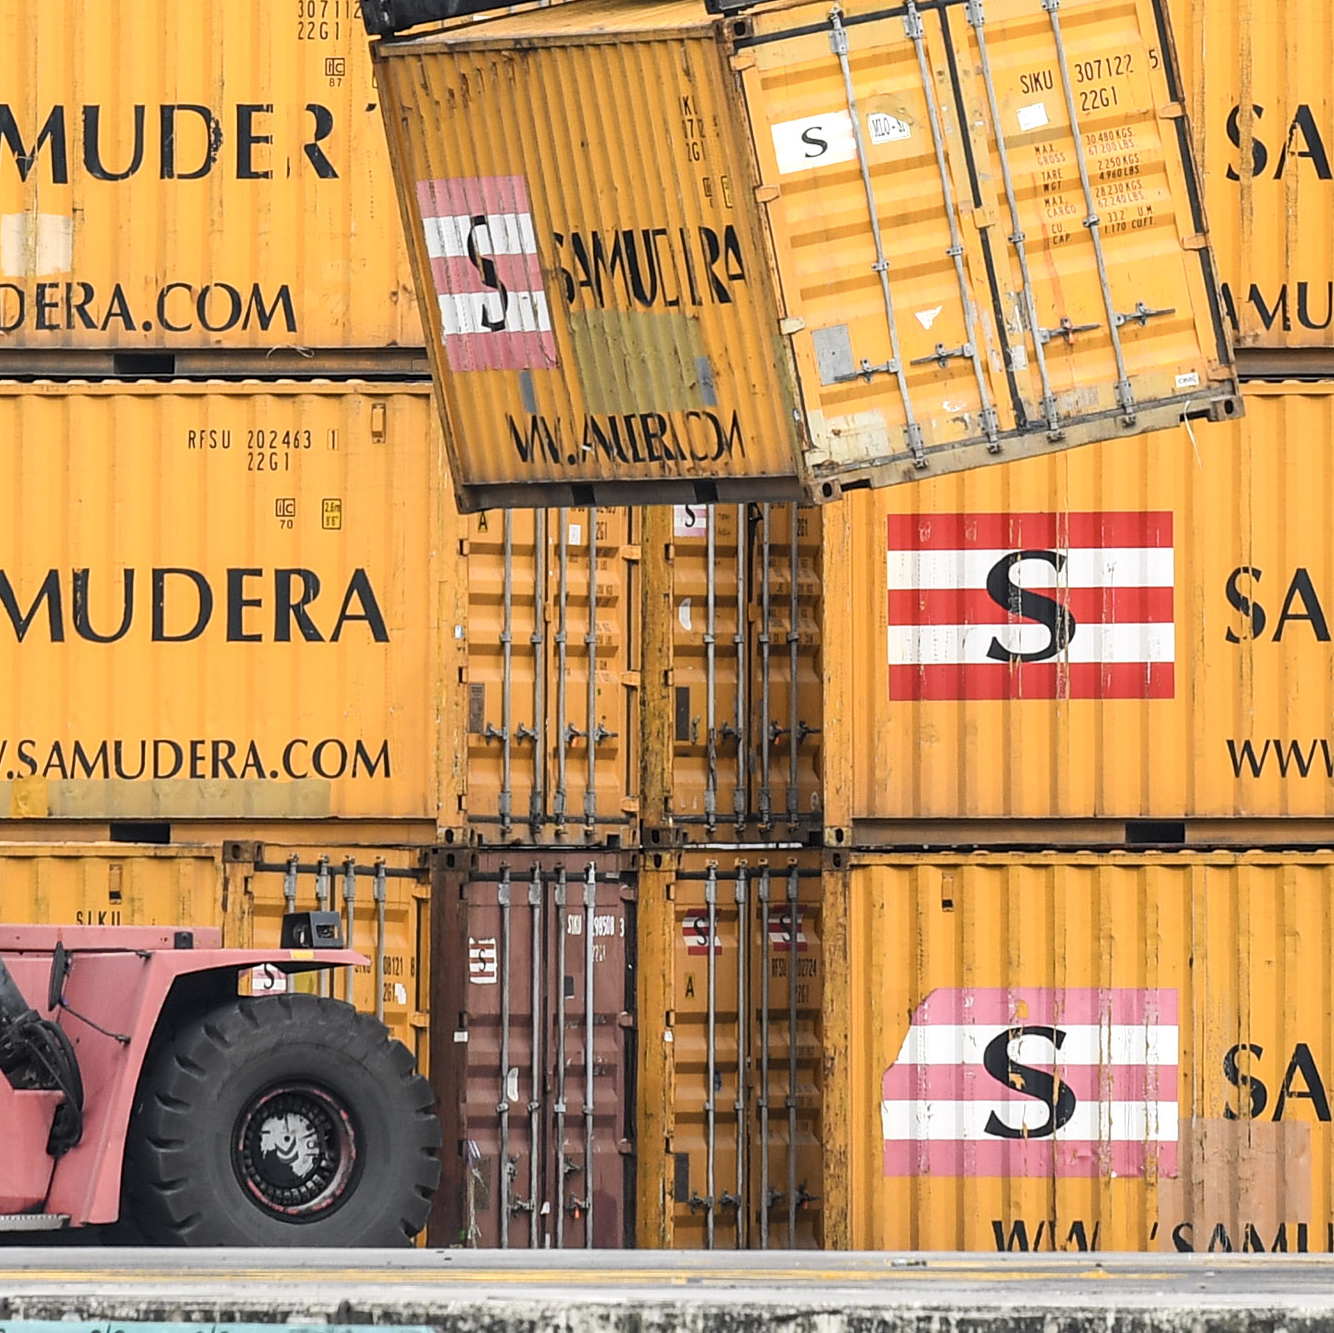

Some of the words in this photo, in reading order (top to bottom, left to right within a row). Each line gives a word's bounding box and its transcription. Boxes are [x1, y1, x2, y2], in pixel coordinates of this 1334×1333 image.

[297, 22, 339, 41] 22G1
[1020, 70, 1054, 95] SIKU
[1074, 54, 1135, 83] 307122
[1148, 48, 1159, 69] 5
[329, 78, 342, 87] 87
[1079, 86, 1118, 112] 22G1
[801, 126, 828, 158] S
[1041, 169, 1064, 180] TARE
[188, 429, 231, 449] RFSU
[247, 429, 312, 449] 202463
[247, 451, 289, 471] 22G1
[279, 519, 294, 529] 70
[986, 549, 1077, 663] S
[983, 1025, 1077, 1139] S
